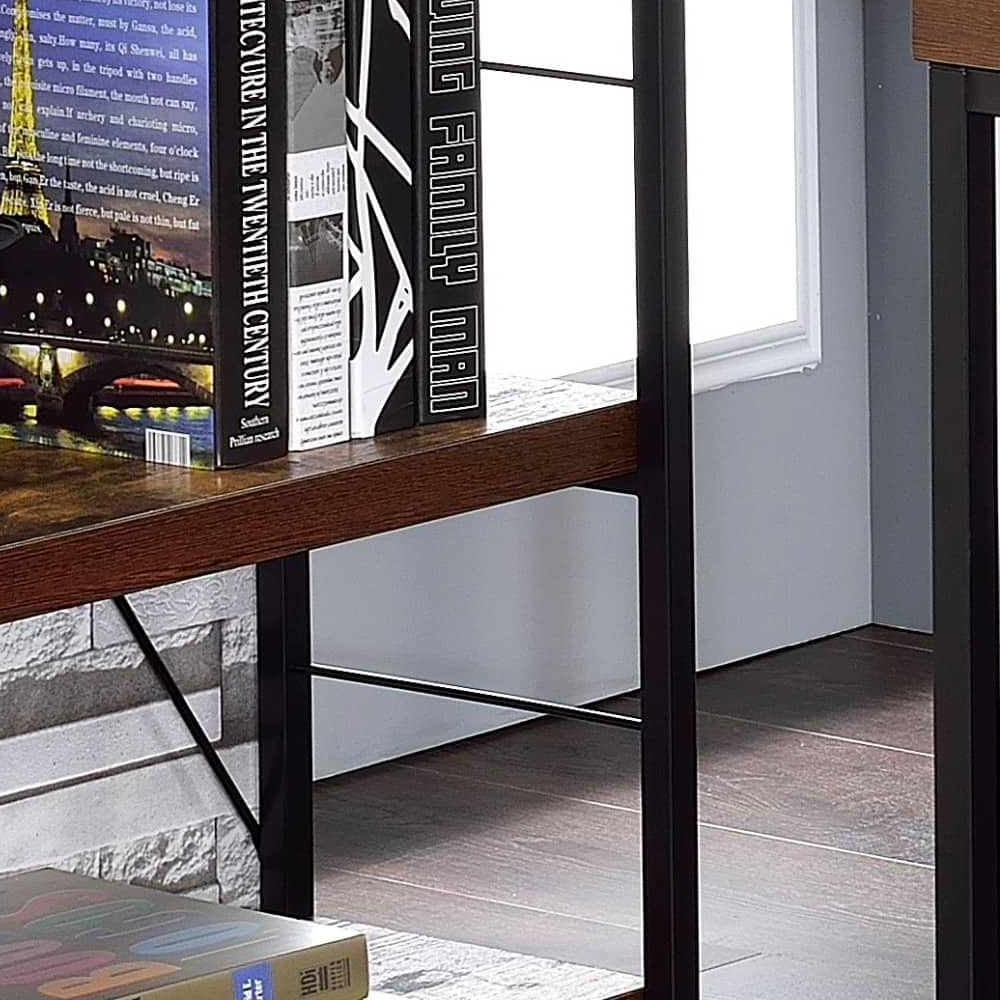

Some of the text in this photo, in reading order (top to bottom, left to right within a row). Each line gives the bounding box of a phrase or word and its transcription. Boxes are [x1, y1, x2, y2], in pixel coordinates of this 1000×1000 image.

[153, 0, 166, 10] not
[168, 0, 184, 12] lose
[186, 2, 196, 13] its
[53, 10, 65, 21] the
[97, 17, 116, 27] must
[119, 18, 128, 31] by
[160, 23, 173, 34] the
[104, 40, 115, 51] its
[168, 48, 179, 59] all
[182, 49, 197, 61] has
[37, 56, 53, 68] gets
[72, 60, 80, 71] in
[83, 61, 96, 73] the
[99, 63, 122, 77] tripod
[126, 67, 143, 78] with
[147, 69, 162, 81] two
[165, 71, 198, 85] handles
[52, 82, 74, 94] micro
[110, 89, 122, 100] the
[124, 92, 148, 104] mouth
[150, 95, 163, 105] not
[165, 98, 179, 107] can
[109, 113, 123, 124] and
[241, 104, 267, 130] IN
[61, 131, 74, 141] and
[150, 141, 166, 153] four
[241, 131, 268, 178] THE
[46, 152, 62, 166] long
[82, 158, 94, 168] not
[95, 158, 107, 170] the
[159, 167, 172, 178] but
[173, 169, 190, 183] ripe
[191, 171, 199, 182] is
[50, 176, 62, 188] the
[85, 181, 97, 192] the
[99, 184, 115, 195] acid
[116, 185, 122, 196] is
[124, 187, 137, 198] not
[189, 195, 199, 206] Er
[429, 111, 478, 286] FAMILY
[54, 200, 60, 211] is
[62, 203, 73, 213] not
[101, 207, 113, 218] but
[114, 210, 130, 221] pale
[132, 211, 138, 222] is
[140, 213, 152, 224] not
[173, 216, 185, 228] but
[188, 218, 199, 230] fat
[241, 179, 269, 307] TWENTIETH
[242, 308, 270, 408] CENTURY
[429, 305, 479, 414] MAN
